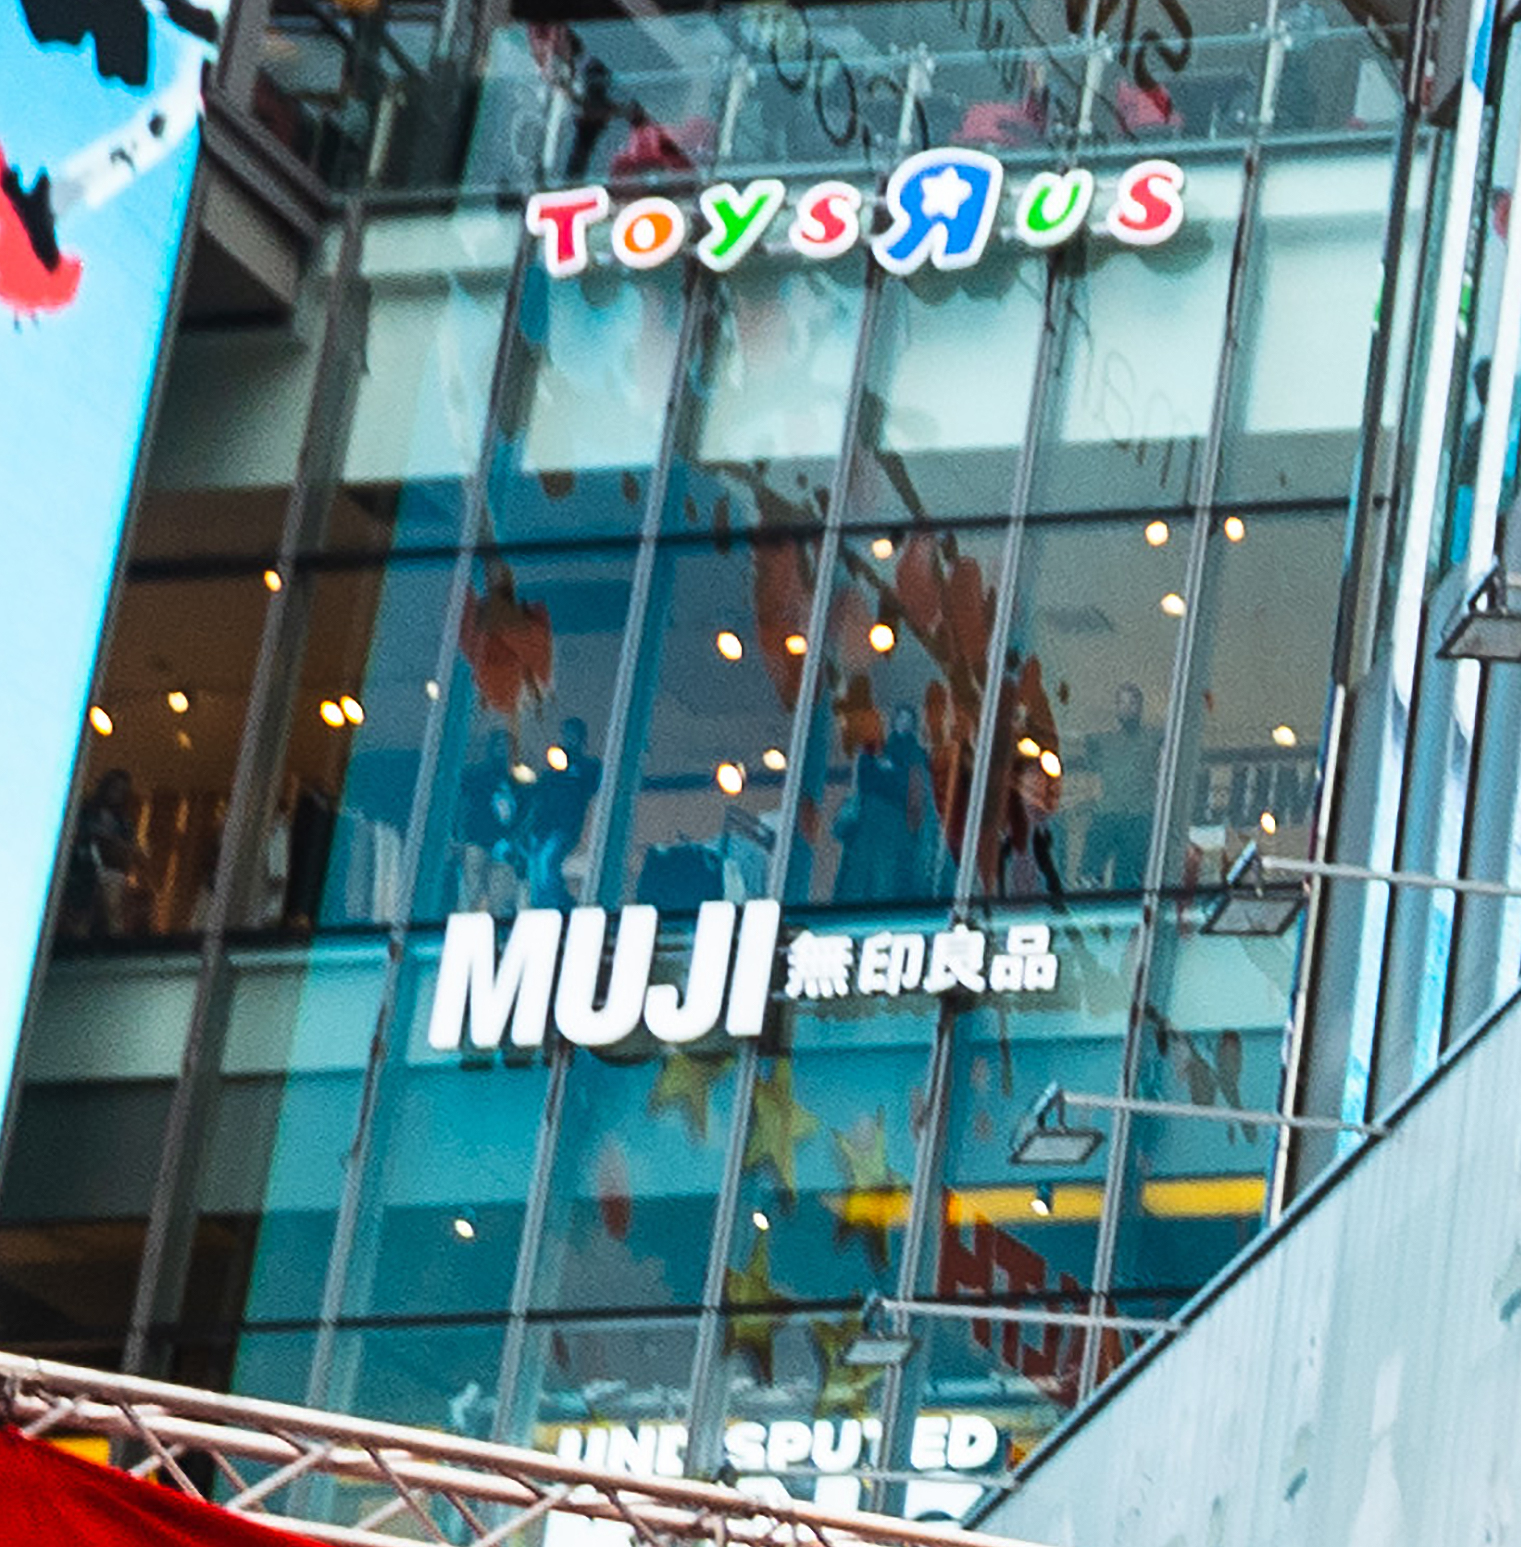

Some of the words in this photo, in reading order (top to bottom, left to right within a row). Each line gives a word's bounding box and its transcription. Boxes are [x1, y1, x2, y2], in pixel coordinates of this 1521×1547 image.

[526, 179, 861, 278] TOYS
[1016, 160, 1184, 247] US
[427, 900, 780, 1049] MUJI
[785, 924, 1058, 999] 無印良品
[557, 1415, 998, 1477] UNDSPUTED
